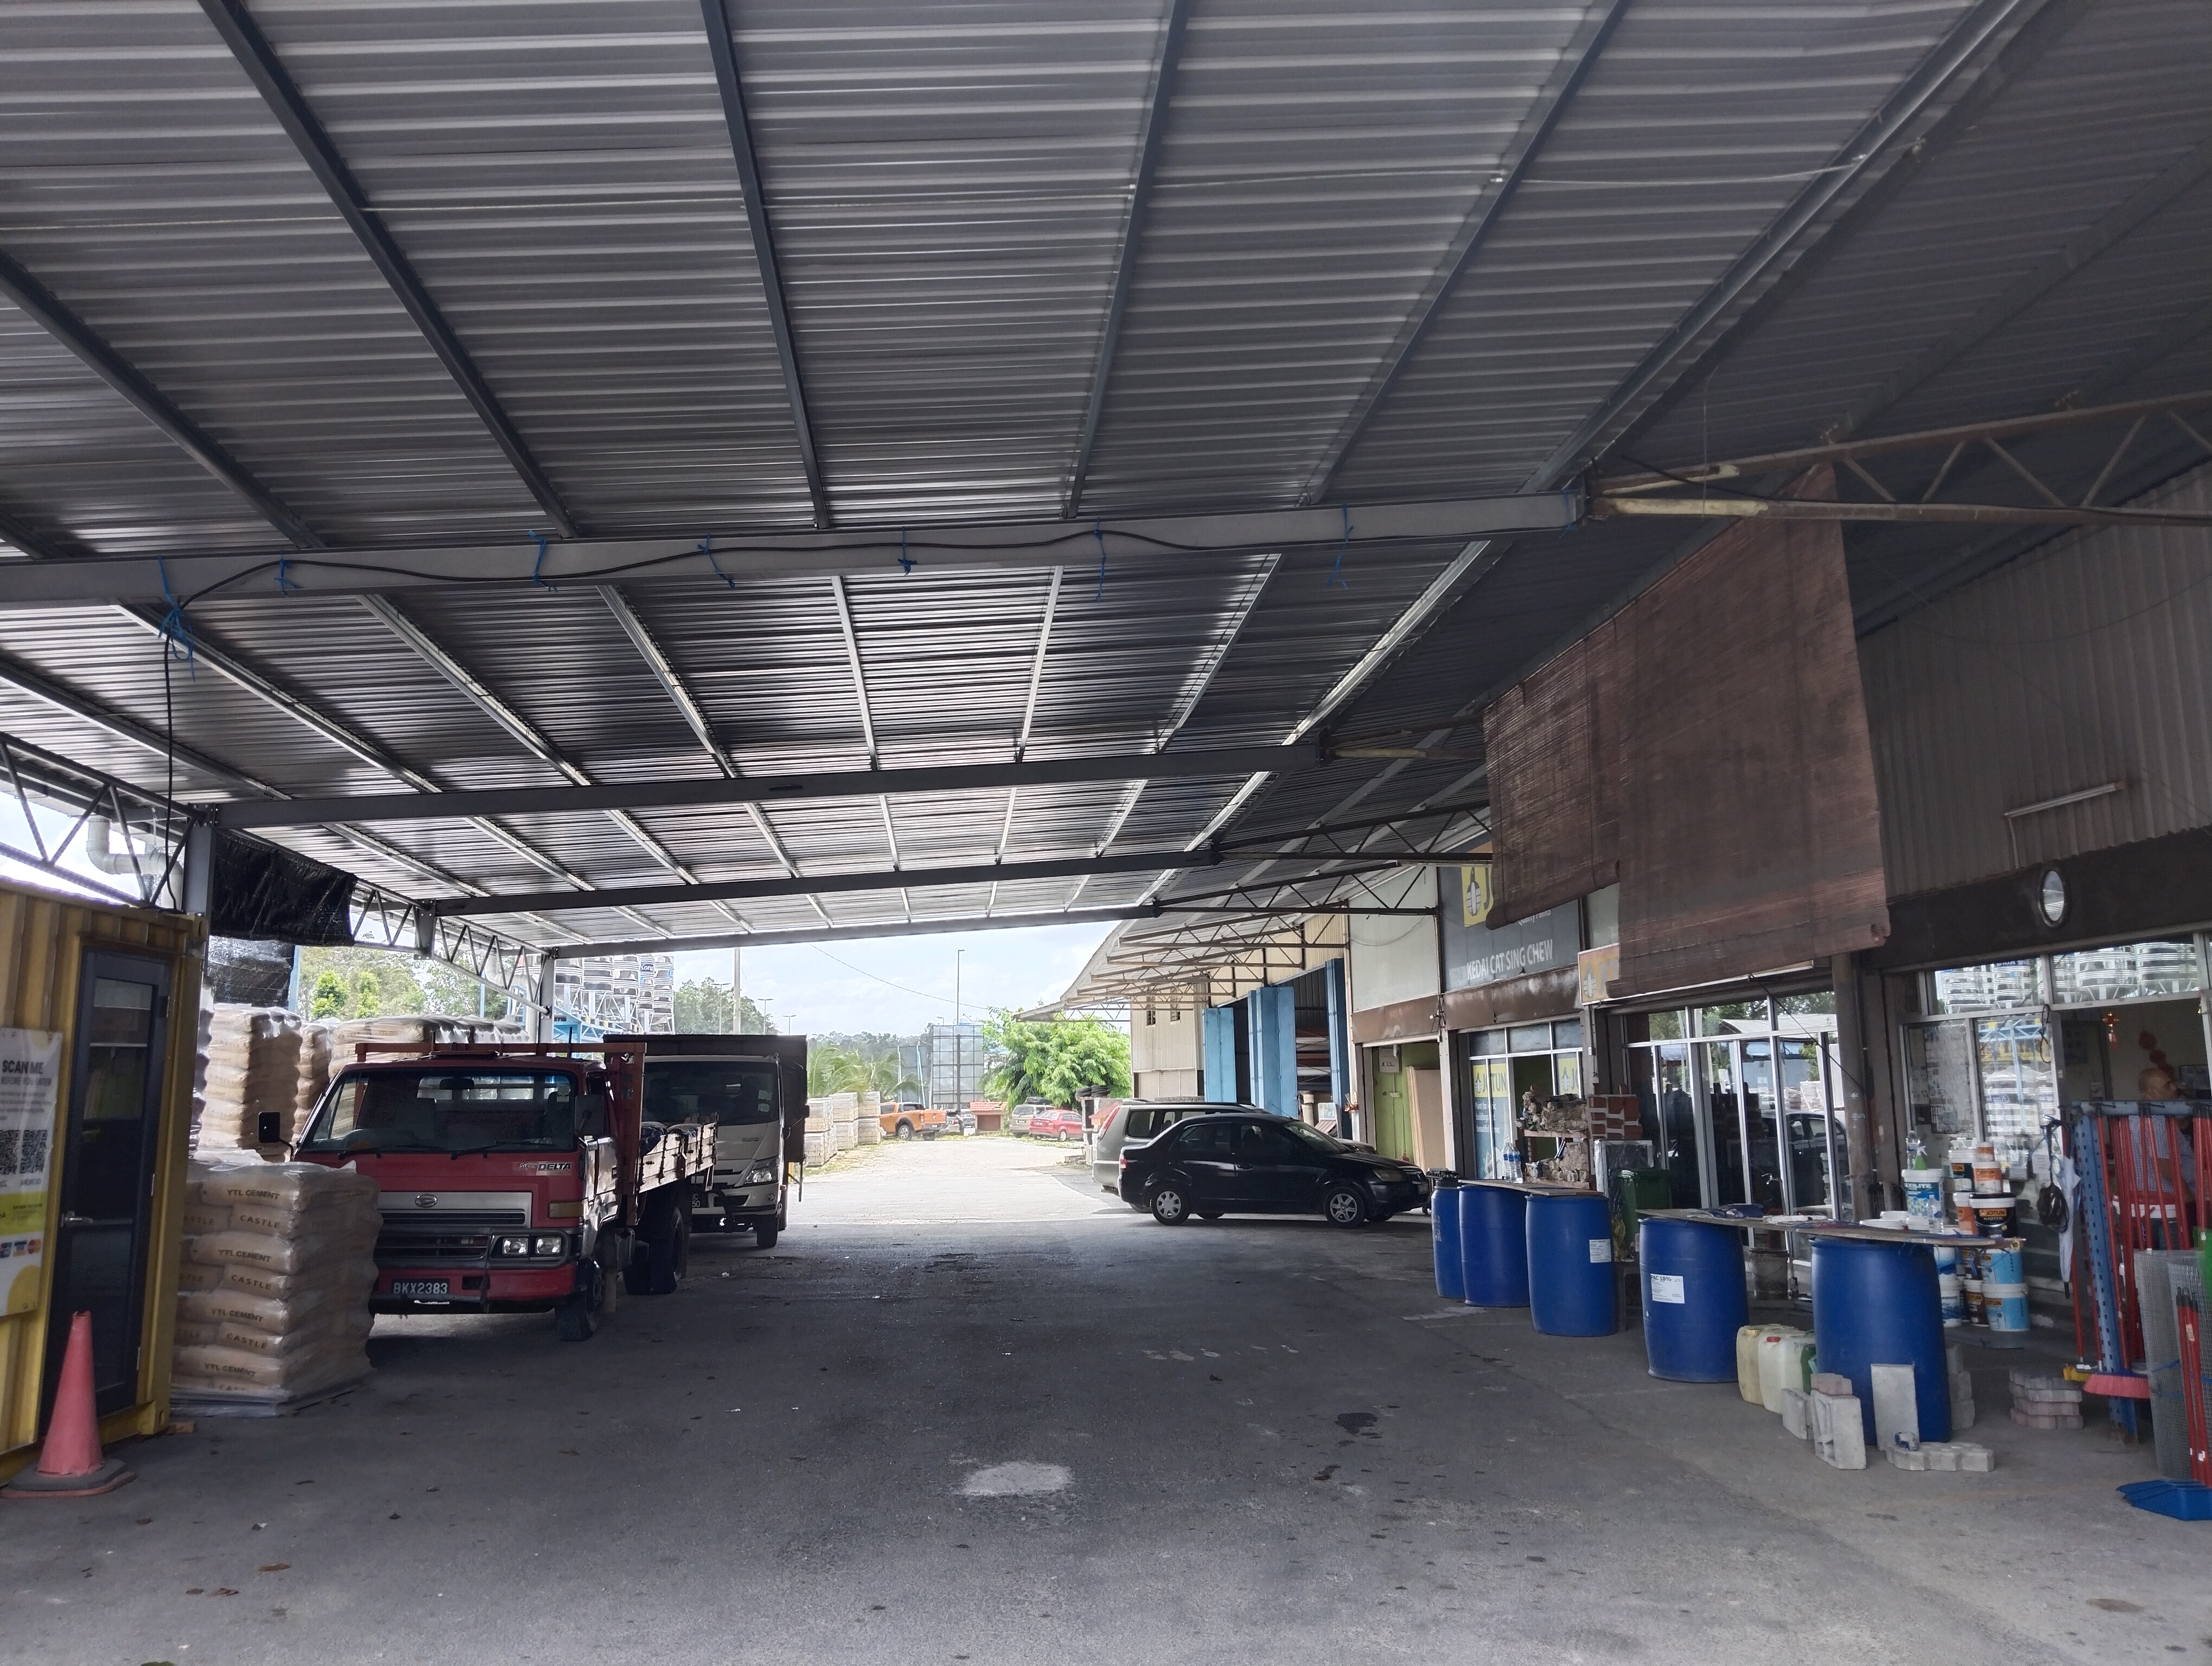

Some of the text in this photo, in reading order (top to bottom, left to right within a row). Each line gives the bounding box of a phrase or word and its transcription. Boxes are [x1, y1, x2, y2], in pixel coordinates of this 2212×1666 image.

[1467, 939, 1553, 980] KEDAI CAT SING CHEW
[2, 1059, 43, 1074] SCAN ME
[246, 1189, 280, 1200] CEMENT
[240, 1215, 281, 1229] CASTLE
[236, 1251, 272, 1263] CEMENT
[232, 1274, 272, 1290] CASTLE
[394, 1282, 448, 1294] BKX2383
[229, 1310, 263, 1322] CEMENT
[226, 1332, 267, 1349] CASTLE
[204, 1362, 221, 1371] YTL
